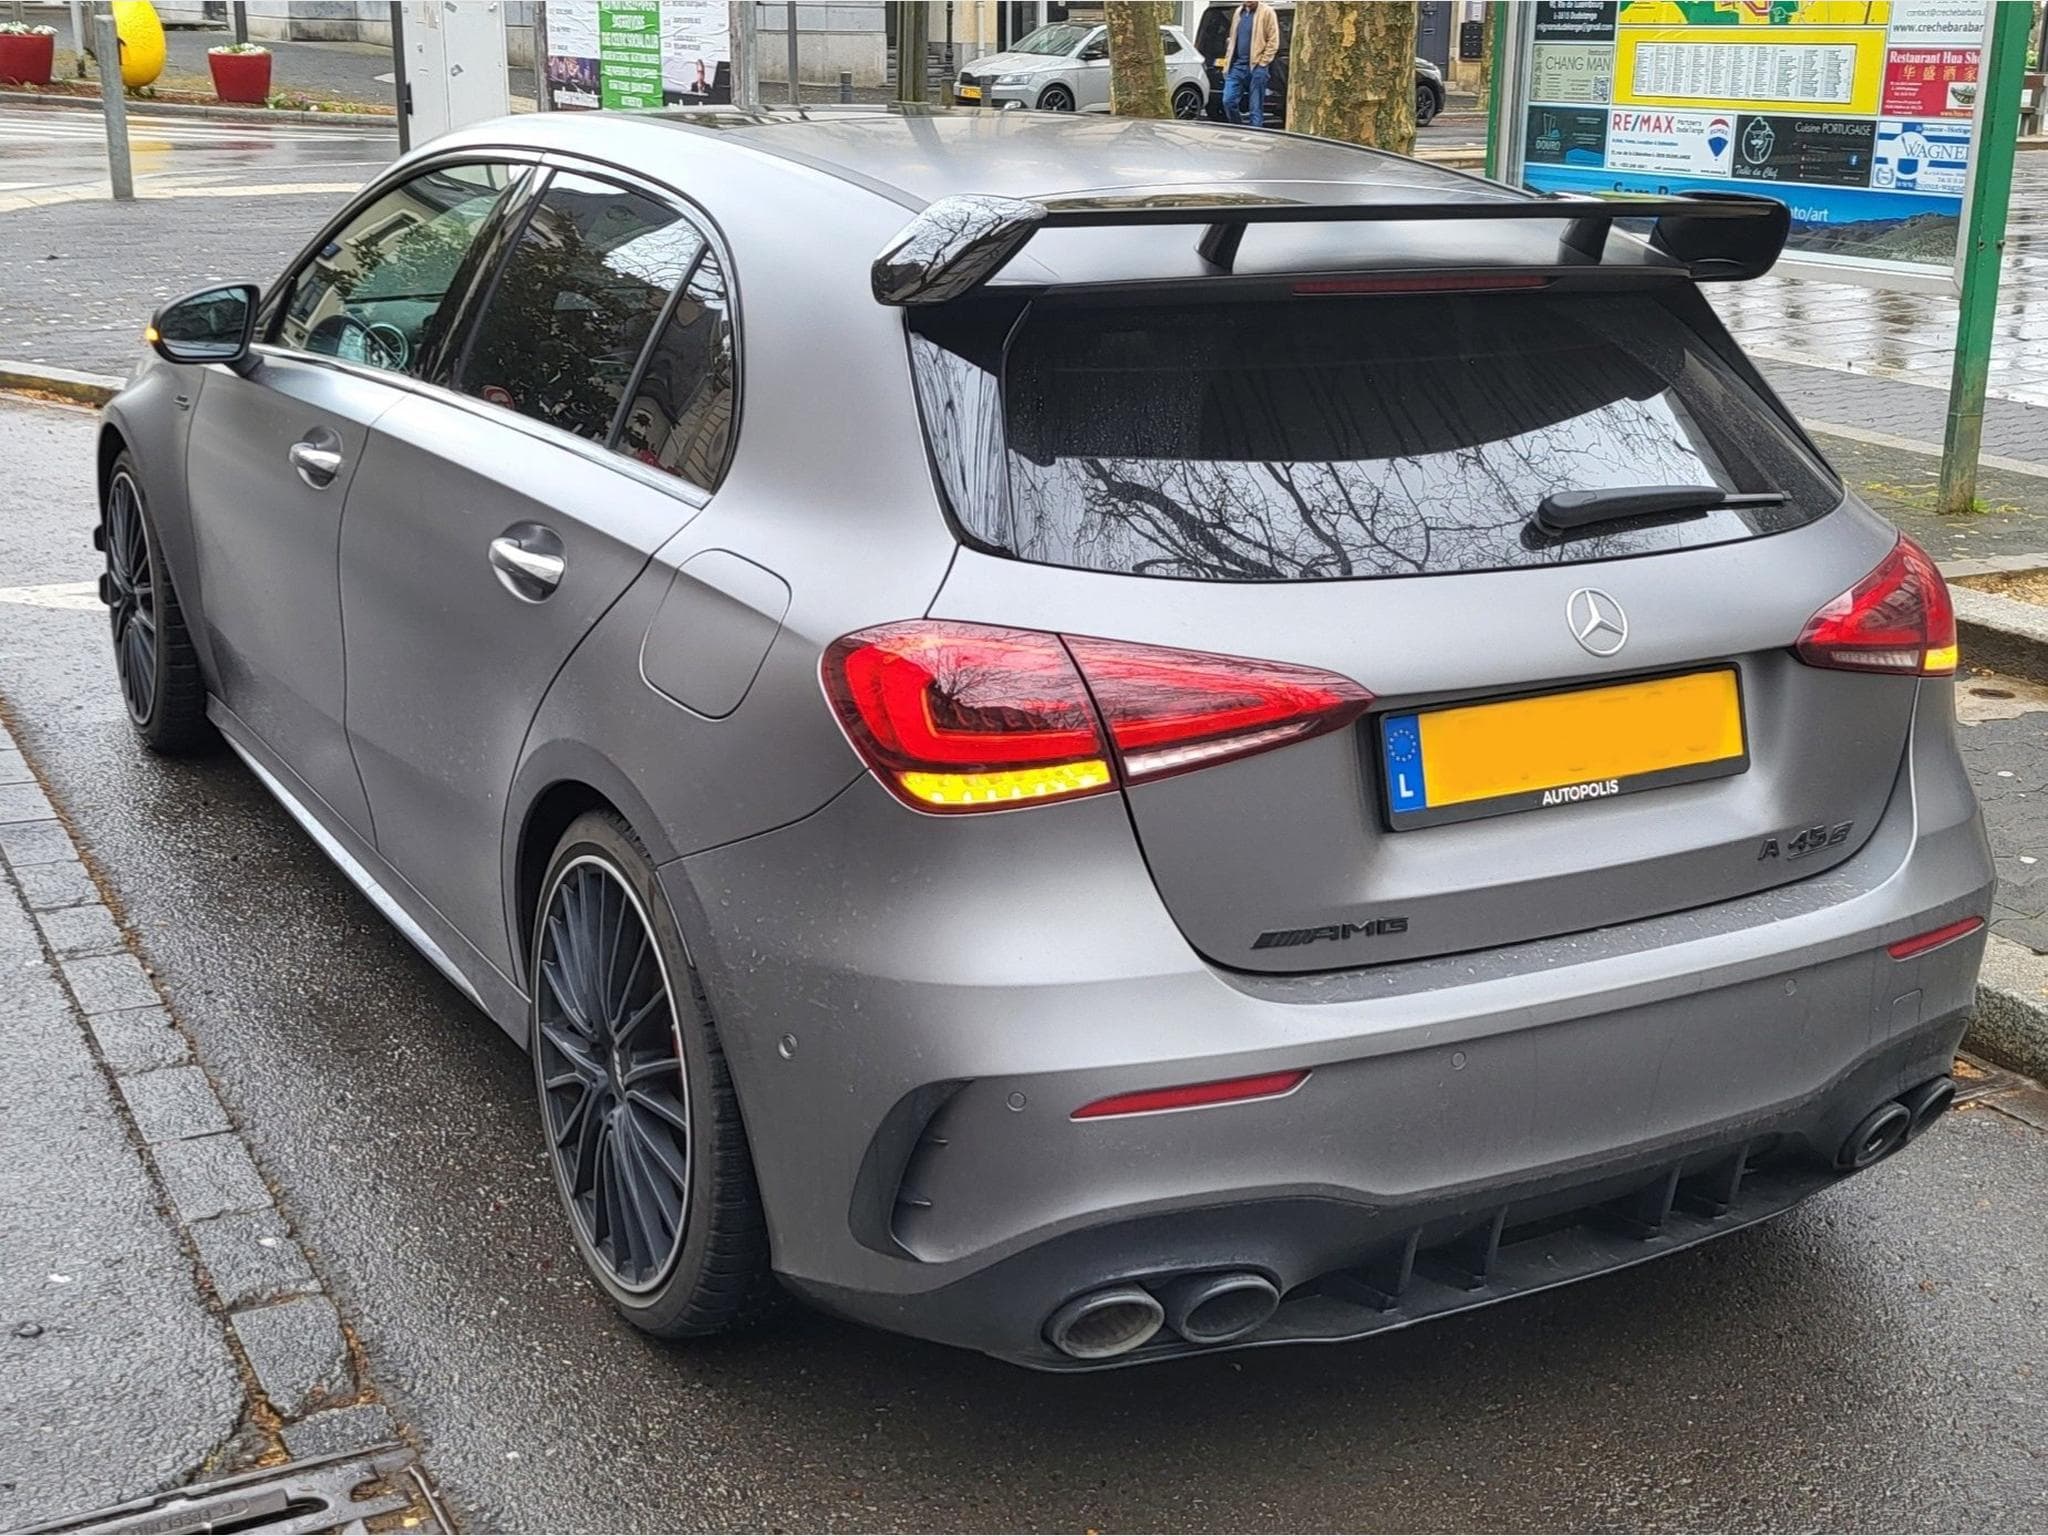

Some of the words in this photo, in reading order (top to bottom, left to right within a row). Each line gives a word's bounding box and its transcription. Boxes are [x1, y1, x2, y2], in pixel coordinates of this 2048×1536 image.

[1545, 56, 1584, 71] CHANG
[1586, 57, 1611, 72] MAN
[1890, 51, 1941, 64] Restaurant
[1943, 51, 1963, 64] Hua
[1612, 113, 1675, 134] RE/MAX
[1795, 122, 1821, 133] Cuisine
[1822, 123, 1872, 136] PORTUGAISE
[1399, 773, 1414, 798] L
[1542, 779, 1619, 806] AUTOPOLIS
[1758, 838, 1780, 861] A
